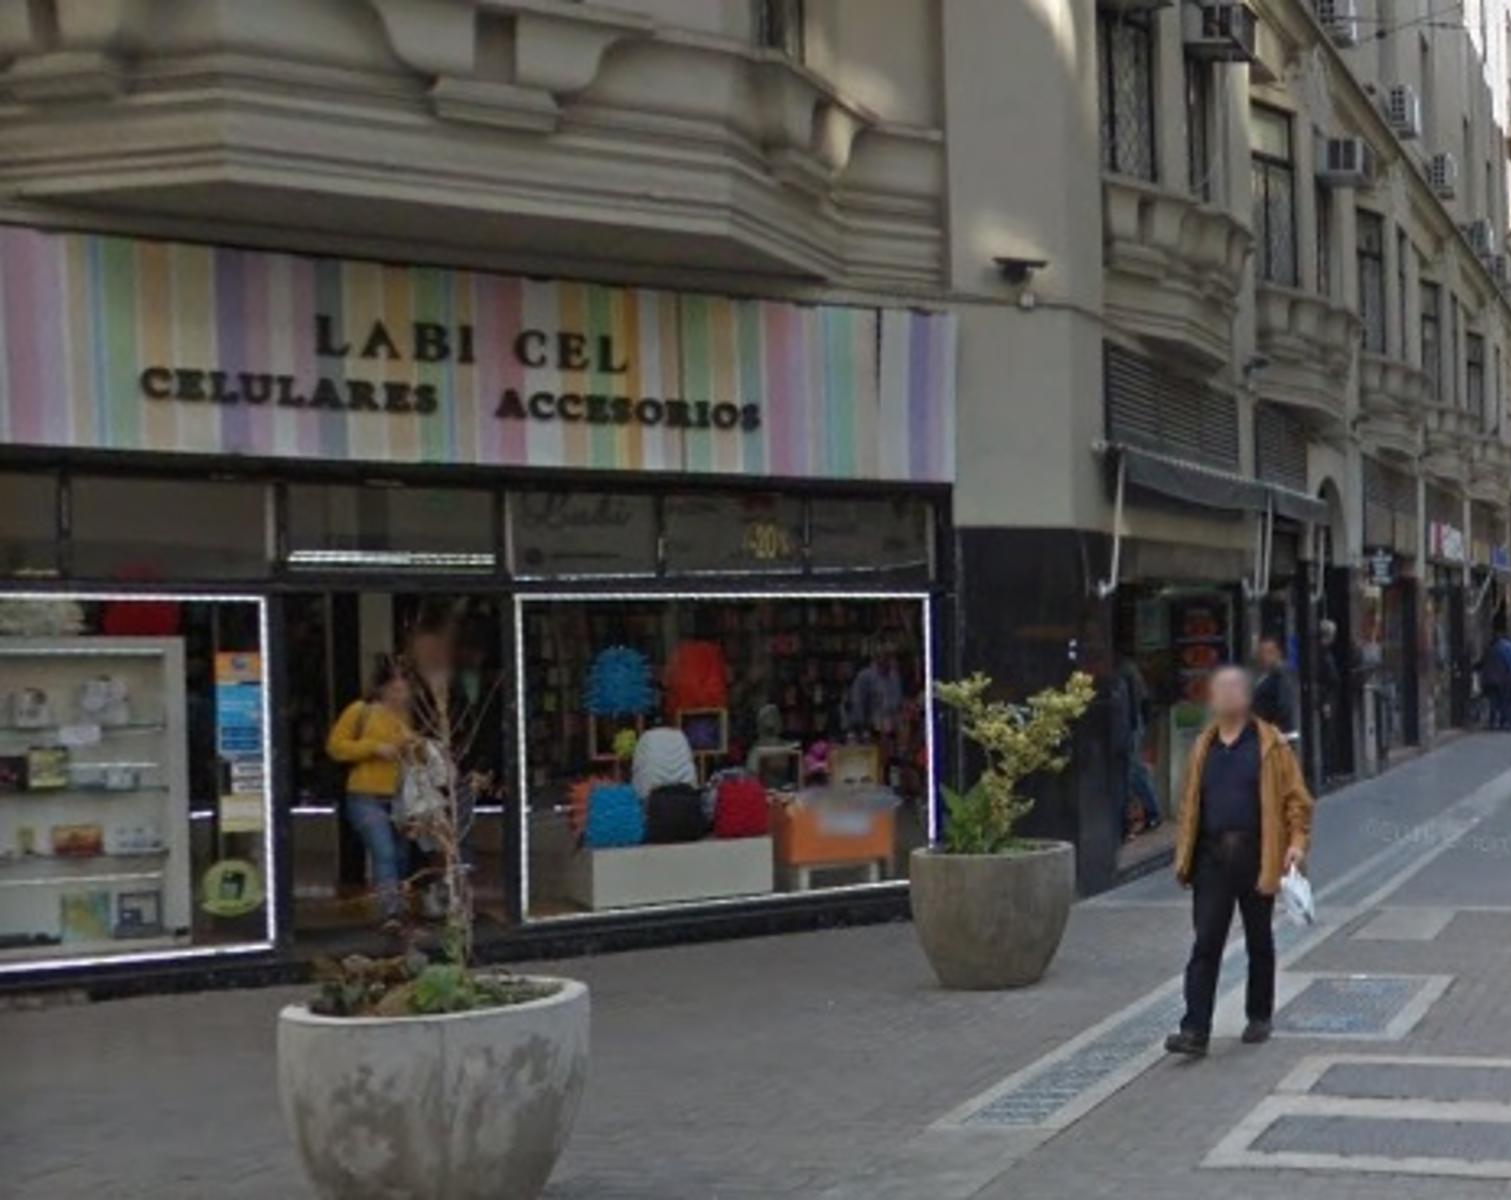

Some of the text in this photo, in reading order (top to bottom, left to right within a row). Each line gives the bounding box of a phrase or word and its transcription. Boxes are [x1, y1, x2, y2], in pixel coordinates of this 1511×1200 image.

[315, 313, 628, 375] LABI CEL
[140, 366, 761, 432] CELULARES ACCESORIOS
